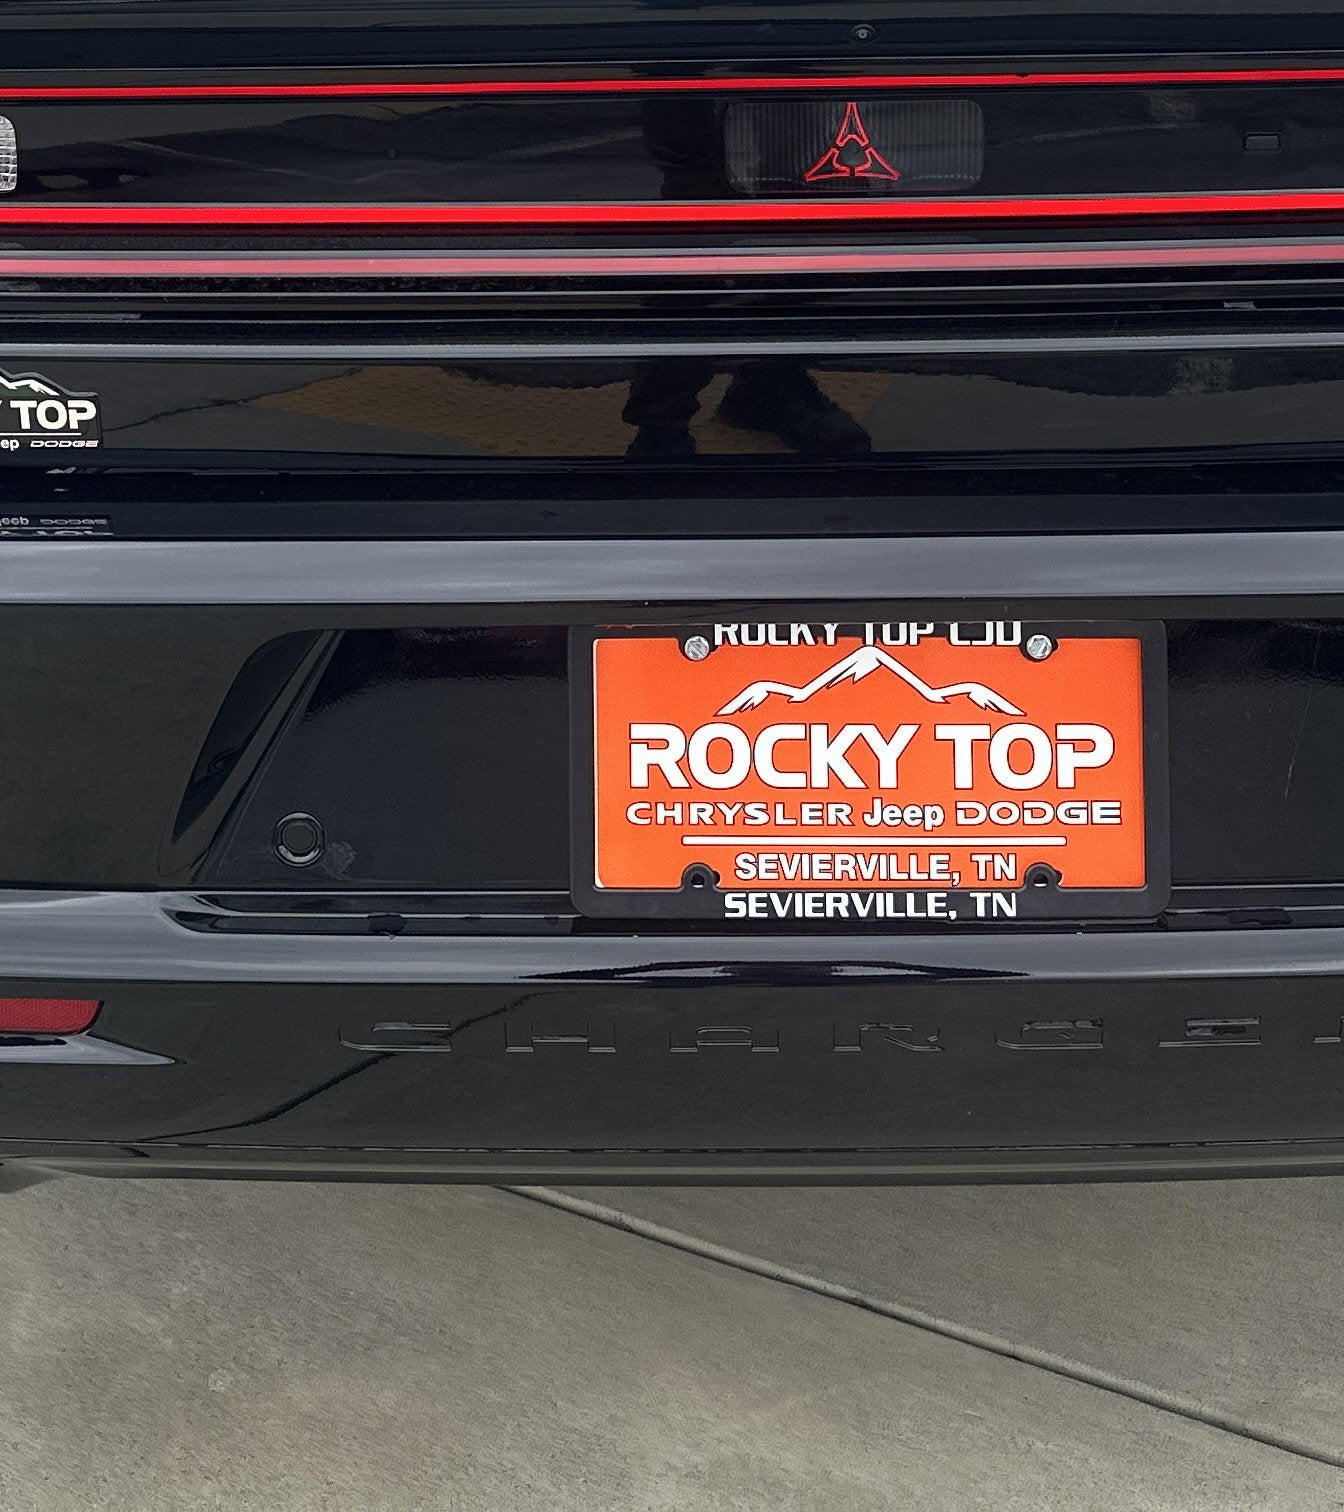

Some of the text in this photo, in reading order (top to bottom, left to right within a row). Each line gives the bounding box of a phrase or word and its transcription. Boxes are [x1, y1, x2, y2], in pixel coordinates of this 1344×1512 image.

[9, 399, 97, 430] TOP
[30, 439, 99, 448] DODGE
[628, 722, 1115, 790] ROCKY TOP
[625, 798, 1122, 831] CHRYSLER Jeep DODGE
[734, 852, 1017, 886] SEVIERVILLE, TN
[723, 892, 1017, 920] SEVIERVILLE, TN
